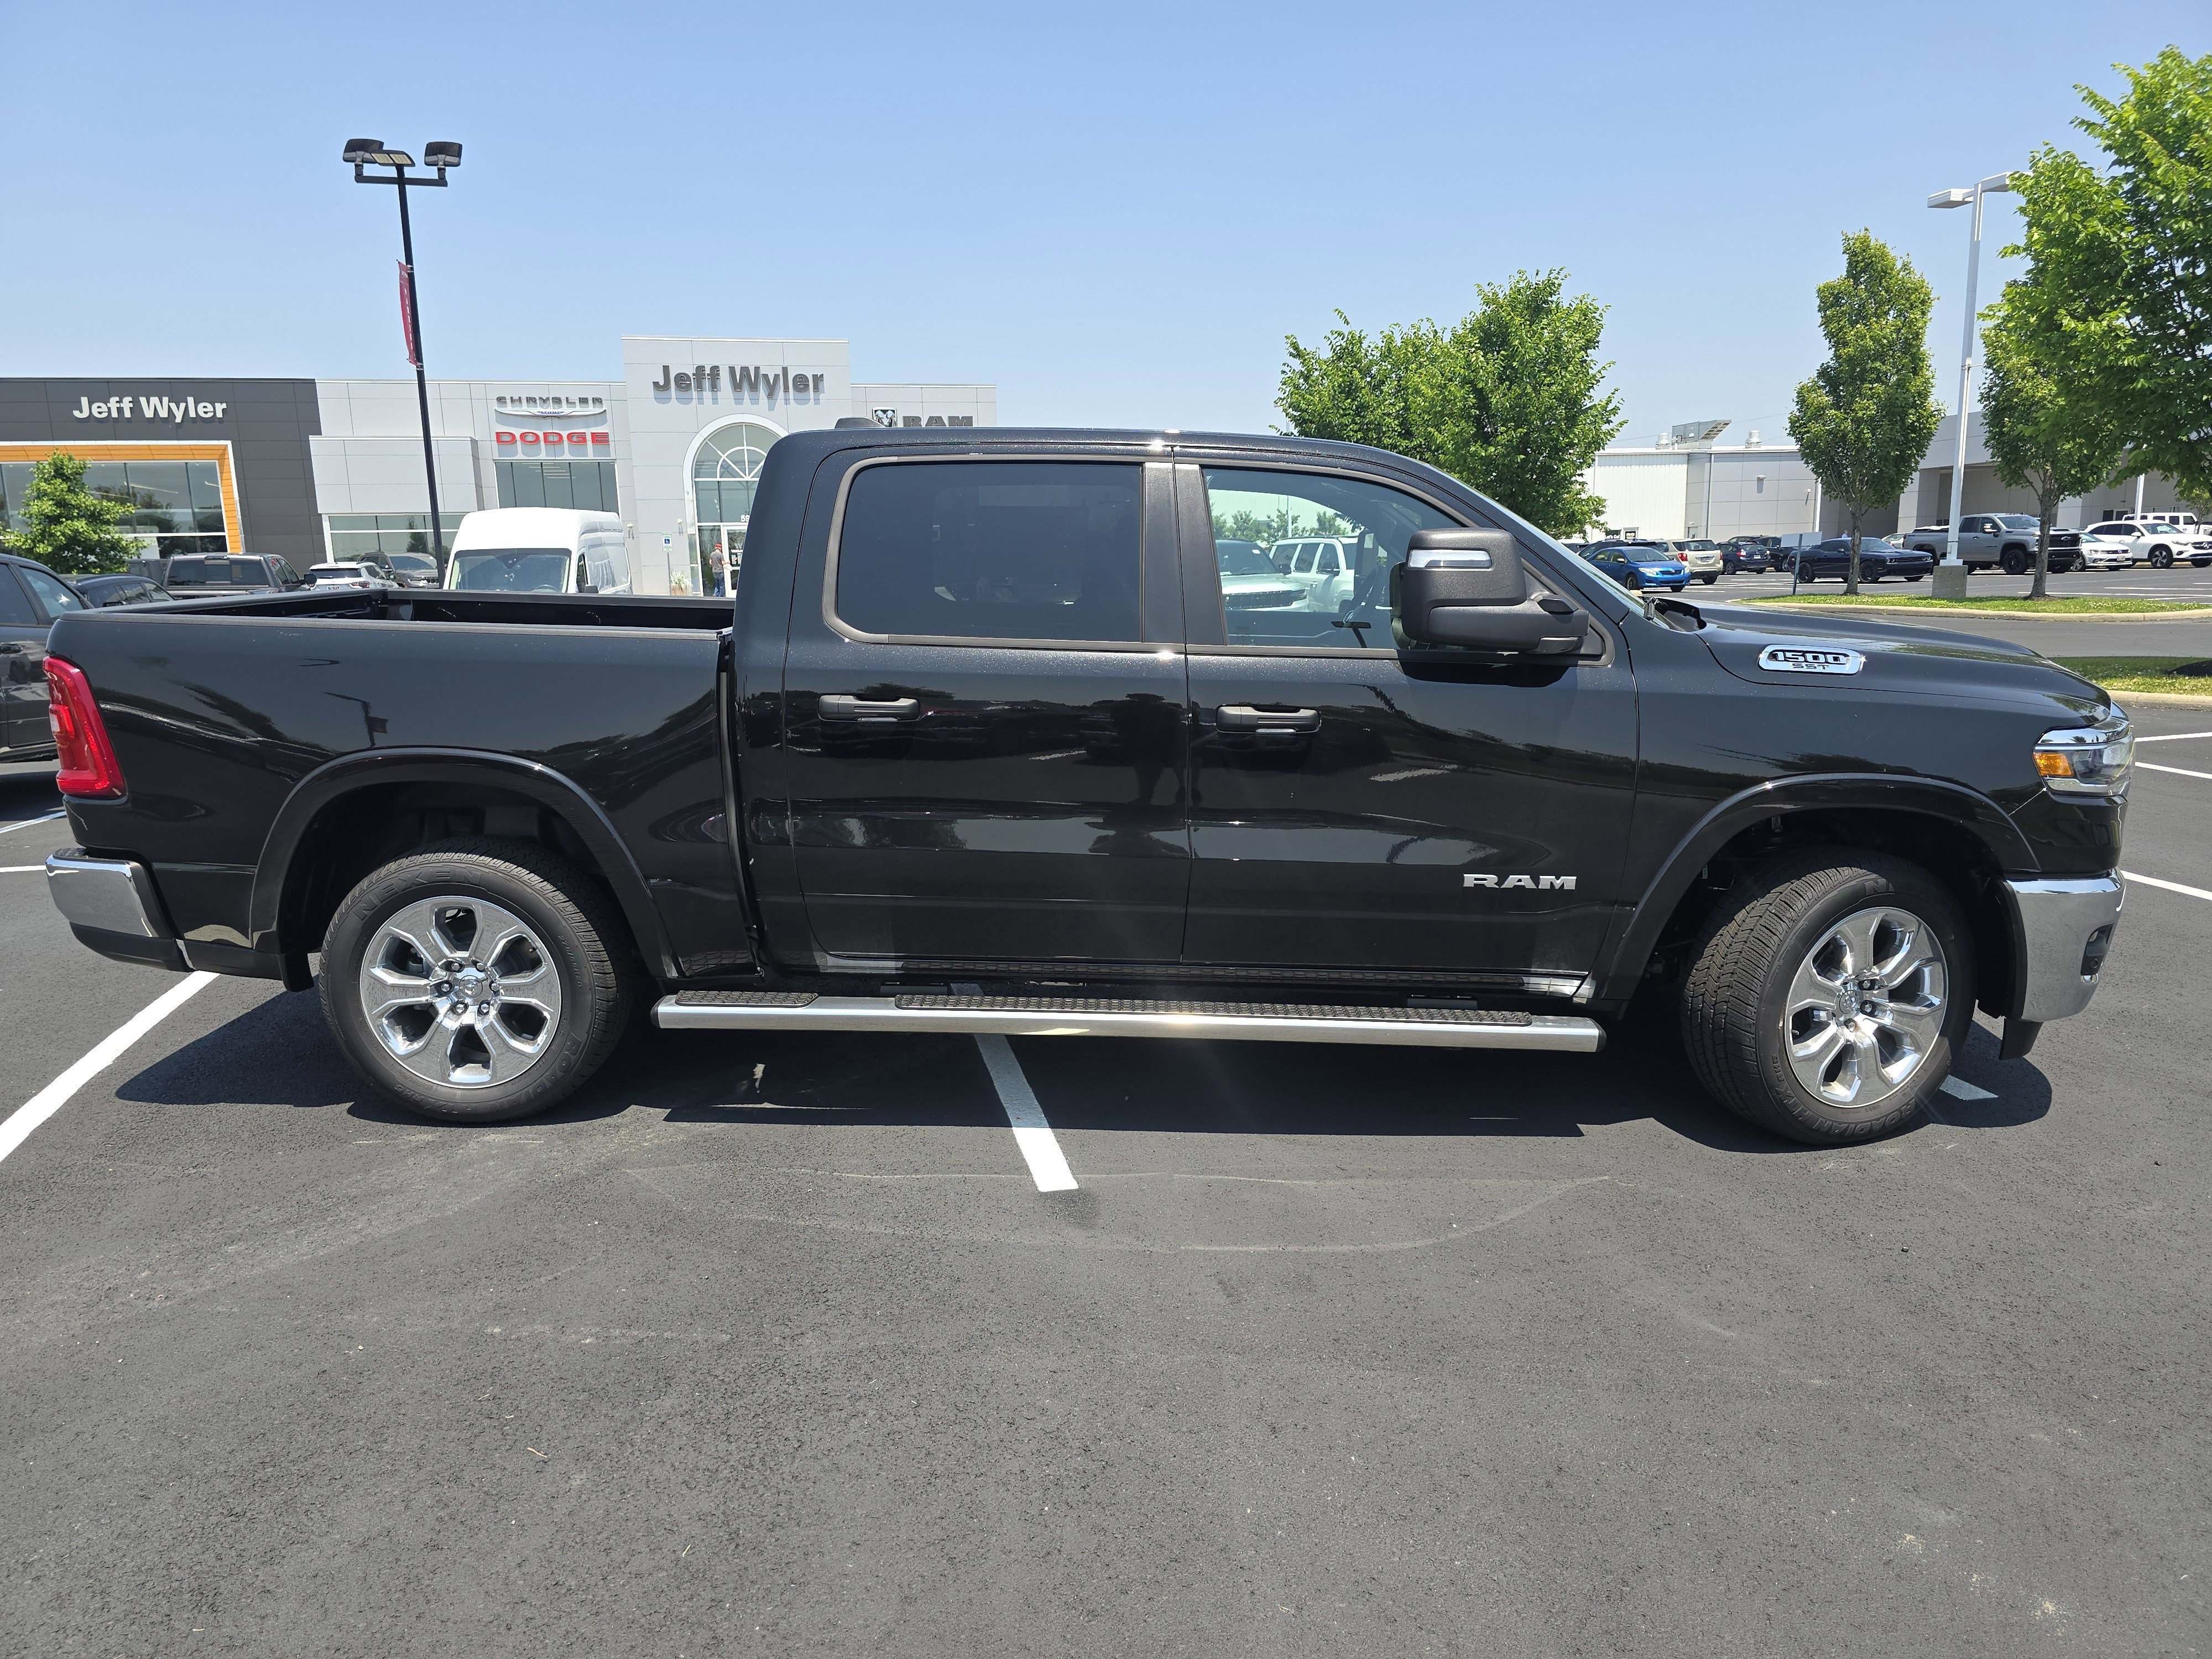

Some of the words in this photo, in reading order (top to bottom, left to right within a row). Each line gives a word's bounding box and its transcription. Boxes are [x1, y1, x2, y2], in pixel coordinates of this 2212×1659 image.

[653, 365, 721, 392] Jeff
[728, 366, 824, 398] Wyler
[496, 396, 603, 404] CHRYSLER
[72, 396, 134, 419] Jeff
[139, 396, 227, 423] Wyler
[902, 416, 973, 427] RAM
[495, 431, 610, 445] DODGE
[1772, 651, 1846, 664] 1500
[1463, 874, 1577, 890] RAM
[354, 868, 482, 921] NEXEN
[1812, 1098, 1916, 1137] ROADIAN
